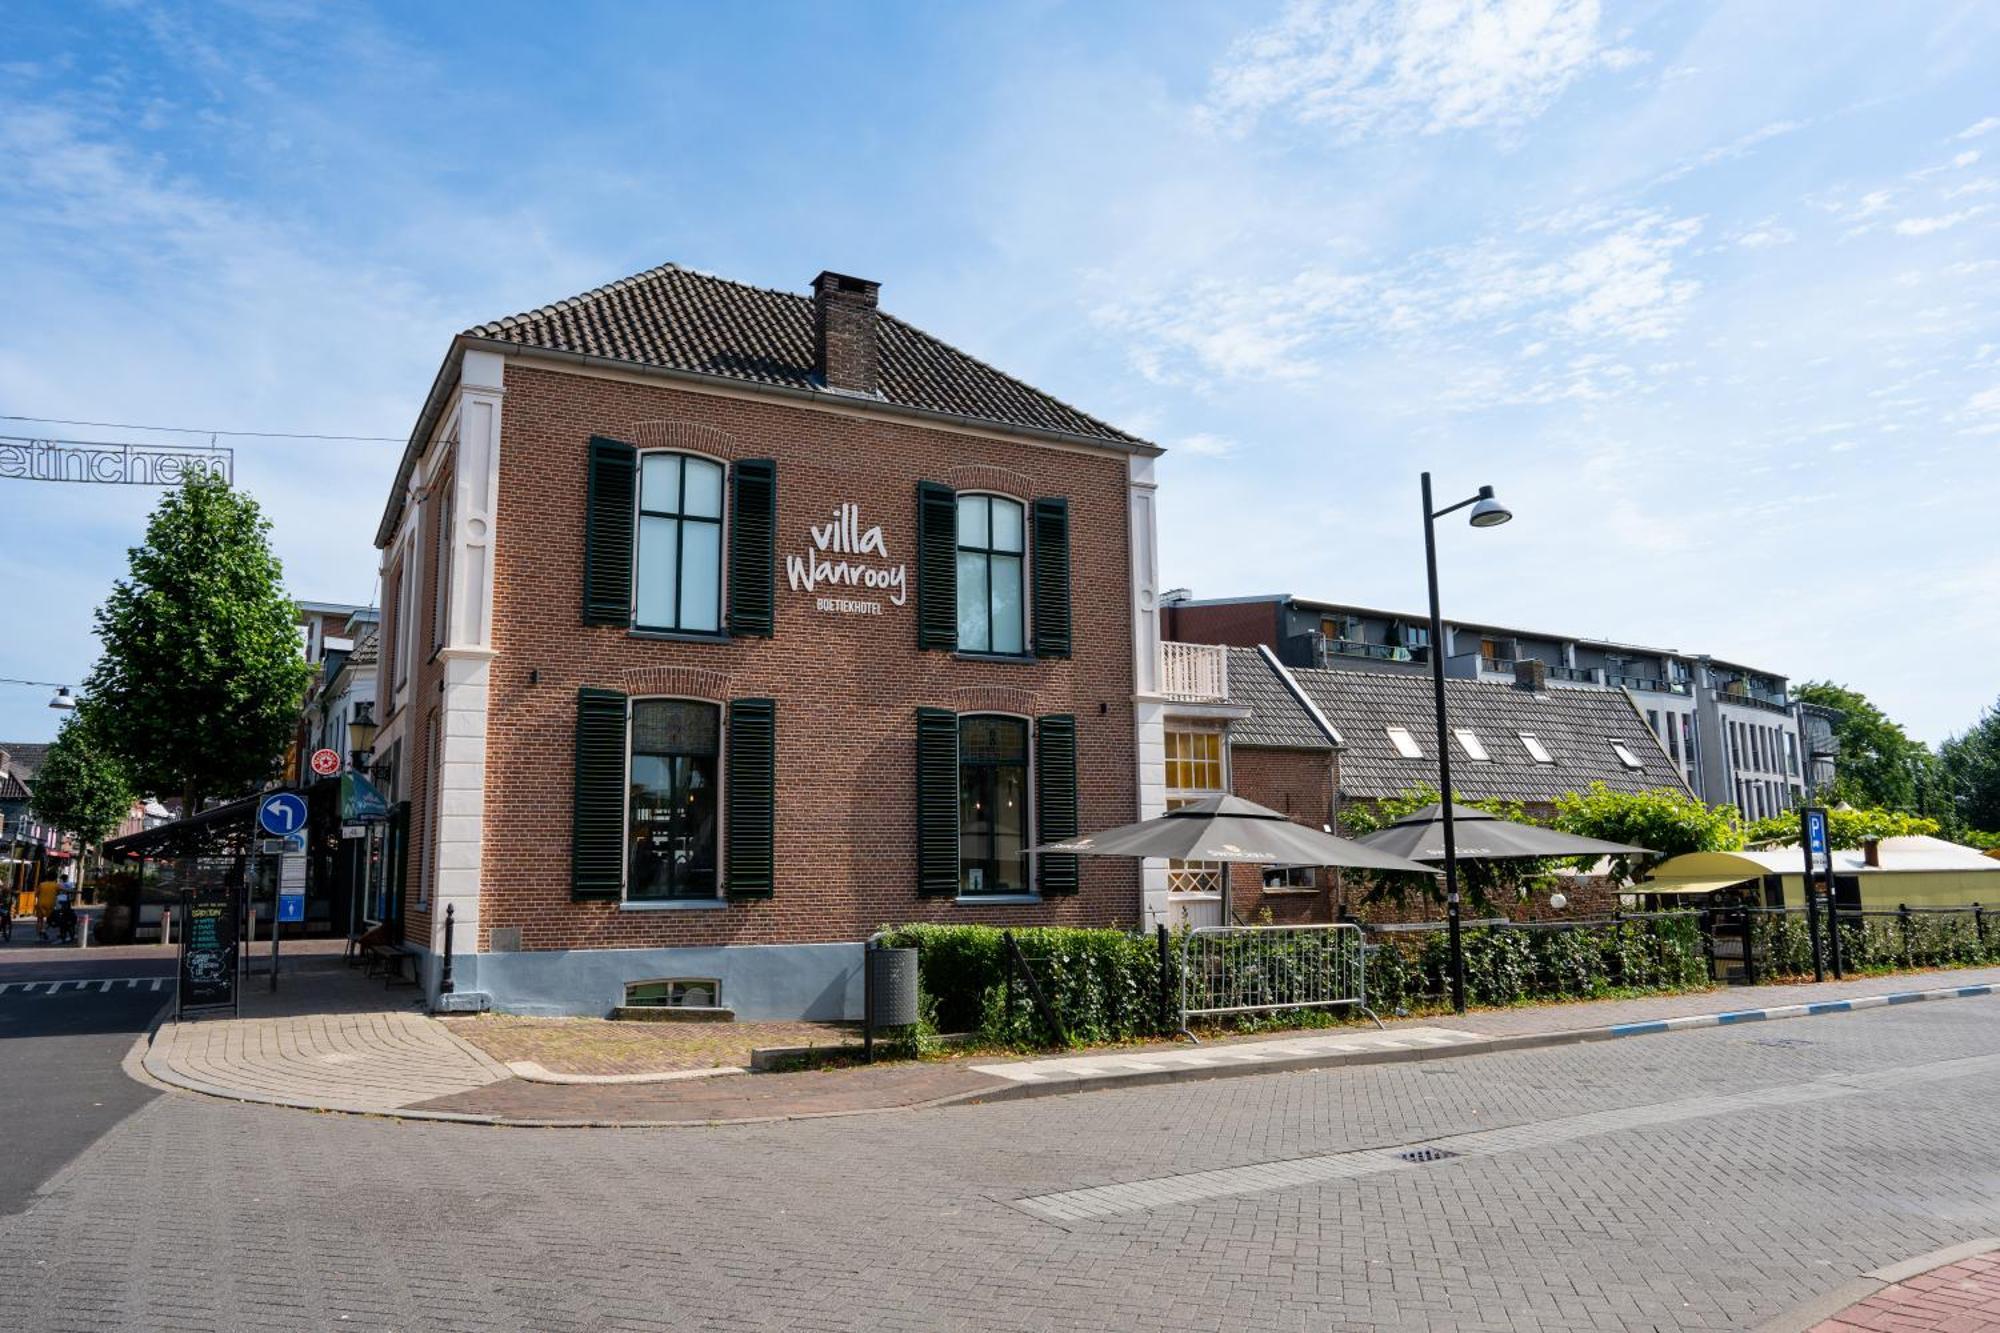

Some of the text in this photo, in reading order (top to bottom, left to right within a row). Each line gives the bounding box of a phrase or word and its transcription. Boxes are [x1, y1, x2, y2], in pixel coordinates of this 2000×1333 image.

[811, 503, 888, 558] villa
[786, 547, 906, 606] Wanrooy
[816, 598, 883, 615] BOETIEKHOTEL
[1811, 818, 1819, 837] P
